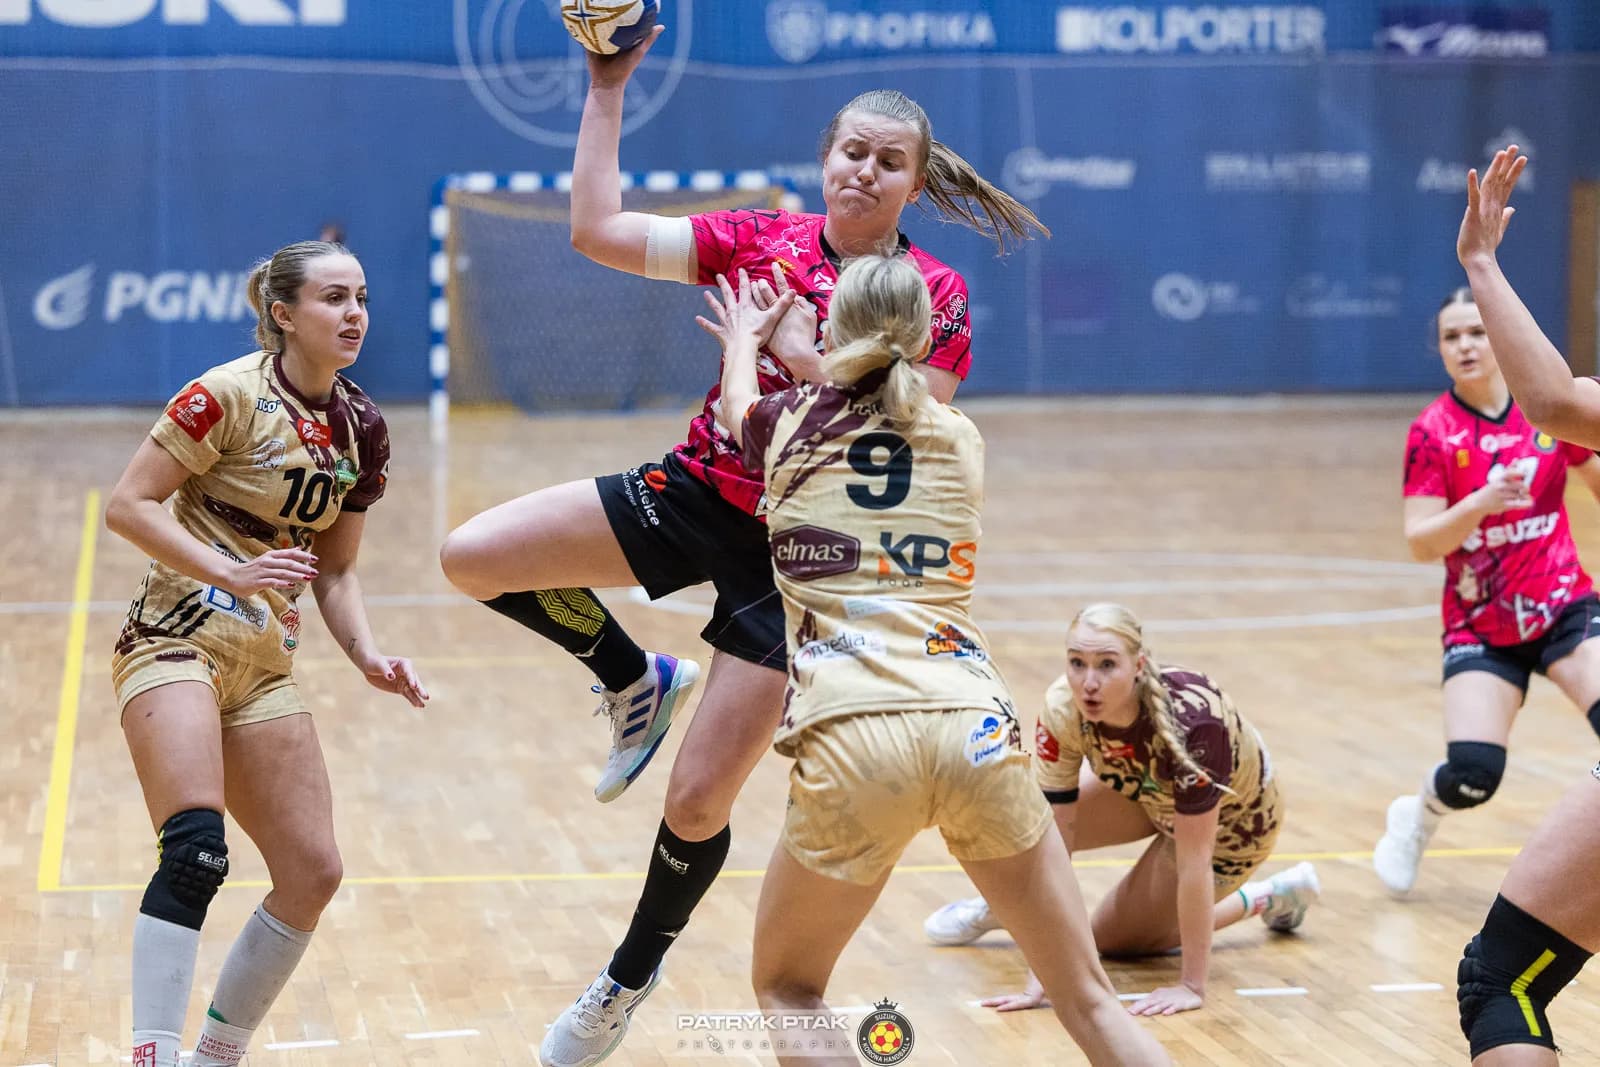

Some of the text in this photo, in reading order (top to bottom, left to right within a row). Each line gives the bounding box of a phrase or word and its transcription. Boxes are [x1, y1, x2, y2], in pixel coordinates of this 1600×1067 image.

[282, 467, 332, 523] 10
[846, 432, 913, 510] 9
[776, 537, 845, 562] elmas
[879, 531, 977, 583] KPS
[197, 851, 226, 867] SELECT
